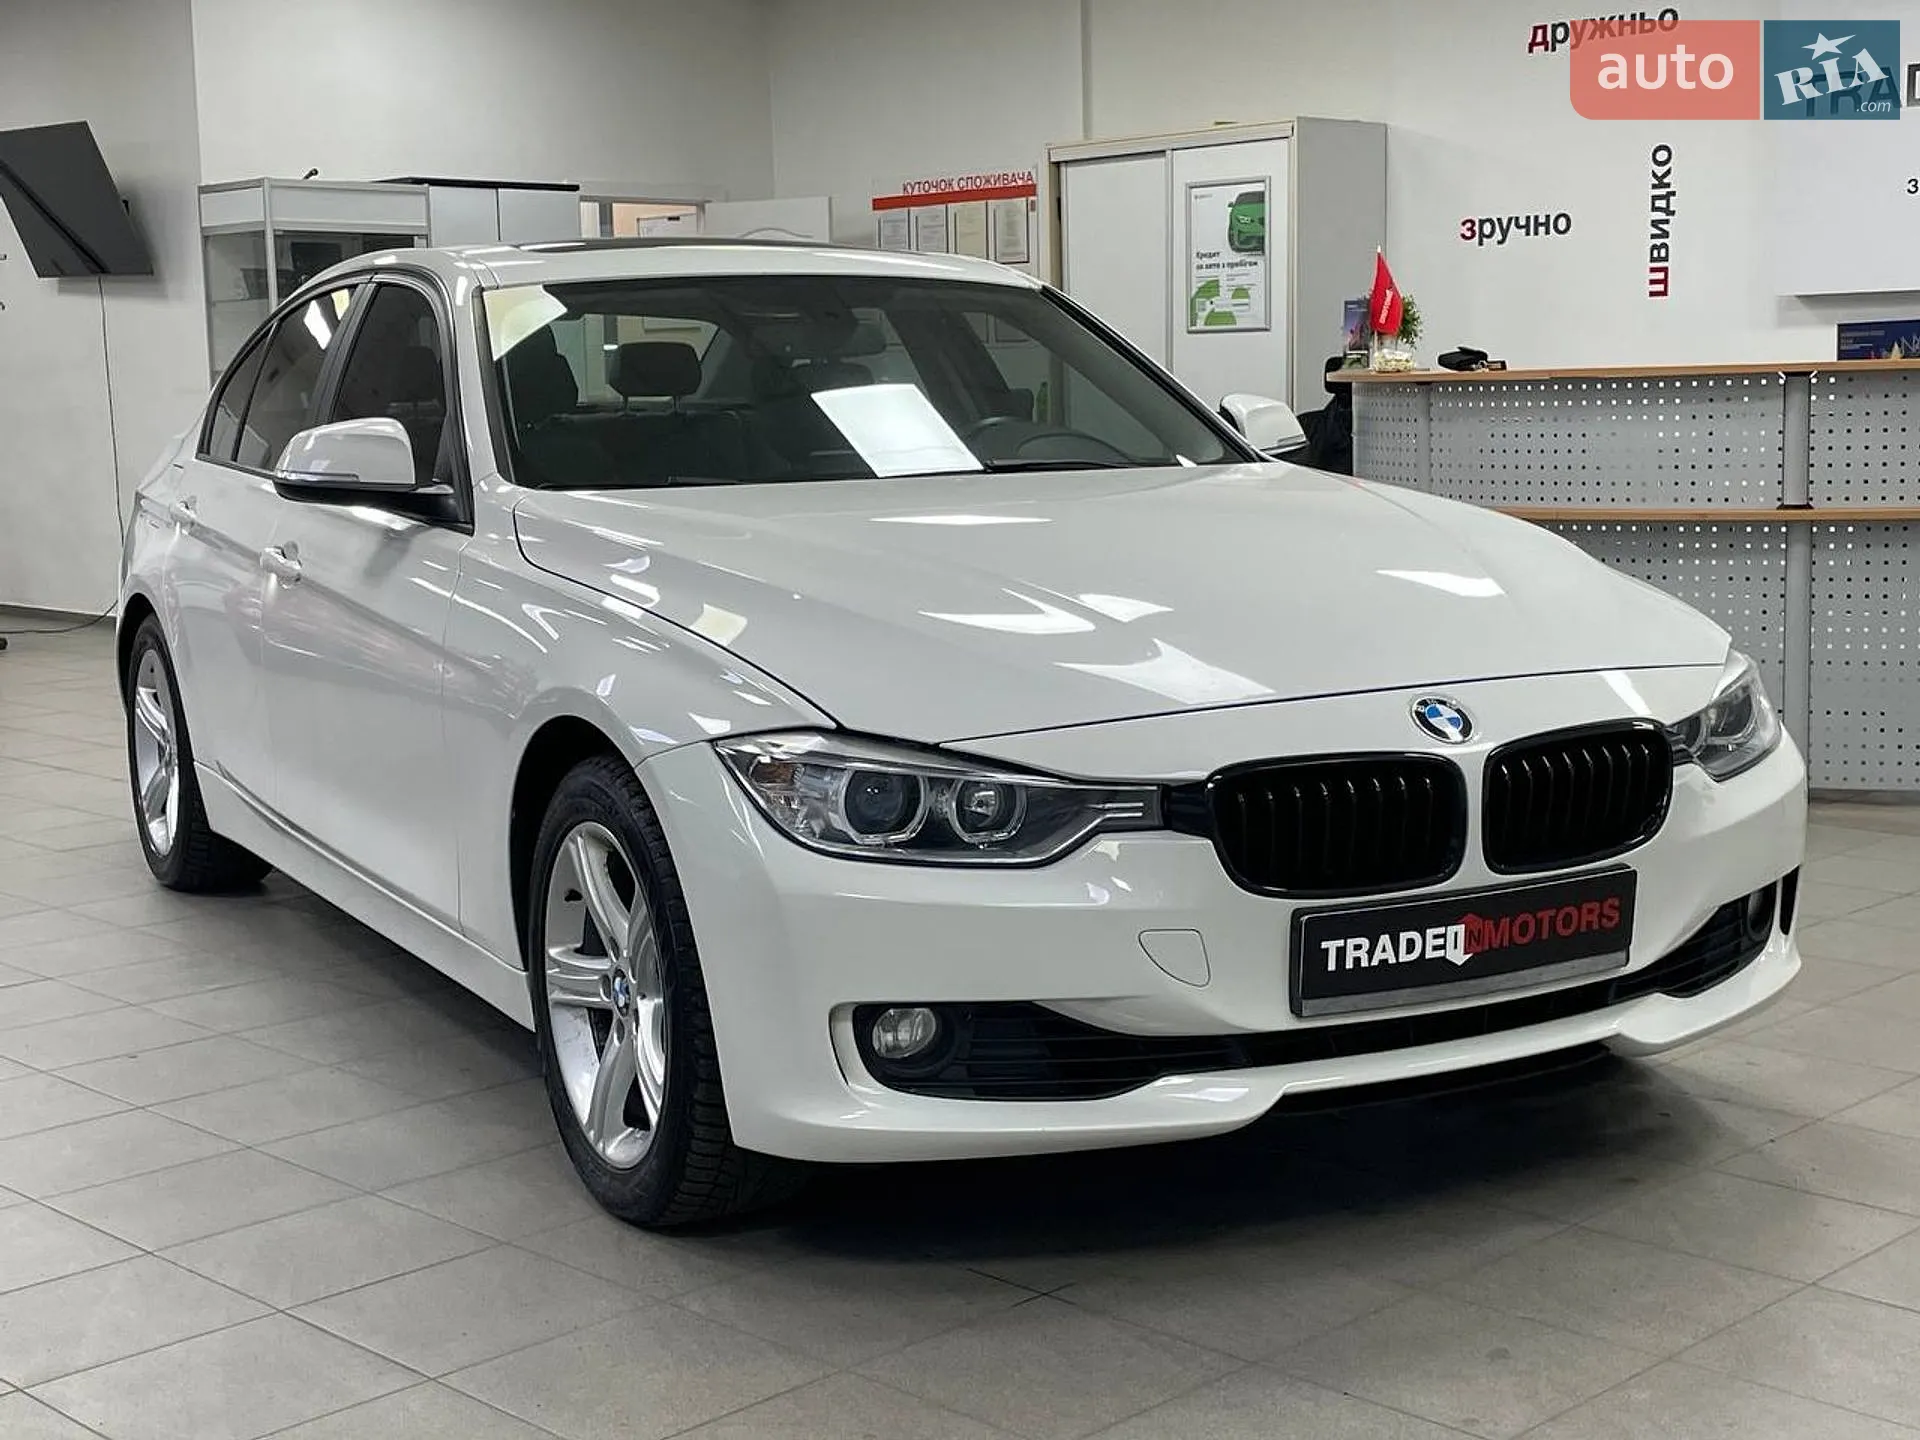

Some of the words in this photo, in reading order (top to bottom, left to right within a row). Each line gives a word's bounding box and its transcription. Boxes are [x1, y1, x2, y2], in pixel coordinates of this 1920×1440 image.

[1528, 7, 1680, 54] дружньо
[902, 178, 955, 195] КУТОЧОК
[957, 170, 1034, 190] СПОЖИВАЧА
[1460, 211, 1572, 246] зручно
[1648, 144, 1677, 298] швидко
